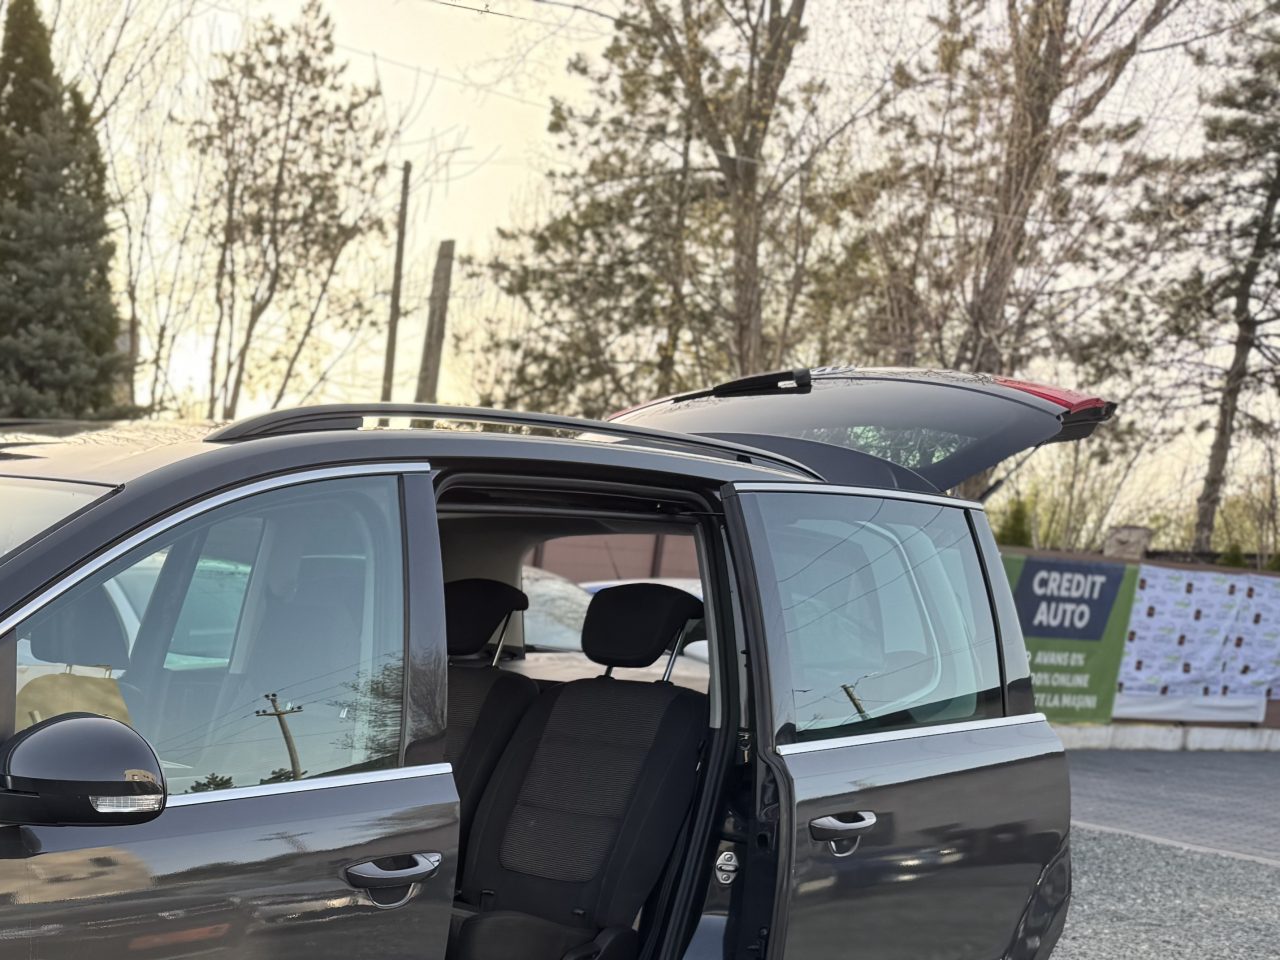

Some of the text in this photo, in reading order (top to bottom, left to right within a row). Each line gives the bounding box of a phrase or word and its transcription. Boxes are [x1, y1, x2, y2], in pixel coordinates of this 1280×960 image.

[1032, 570, 1106, 599] CREDIT
[1033, 601, 1090, 629] AUTO
[1034, 650, 1069, 666] AVANS
[1051, 673, 1090, 688] ONLINE
[1046, 694, 1059, 708] LA
